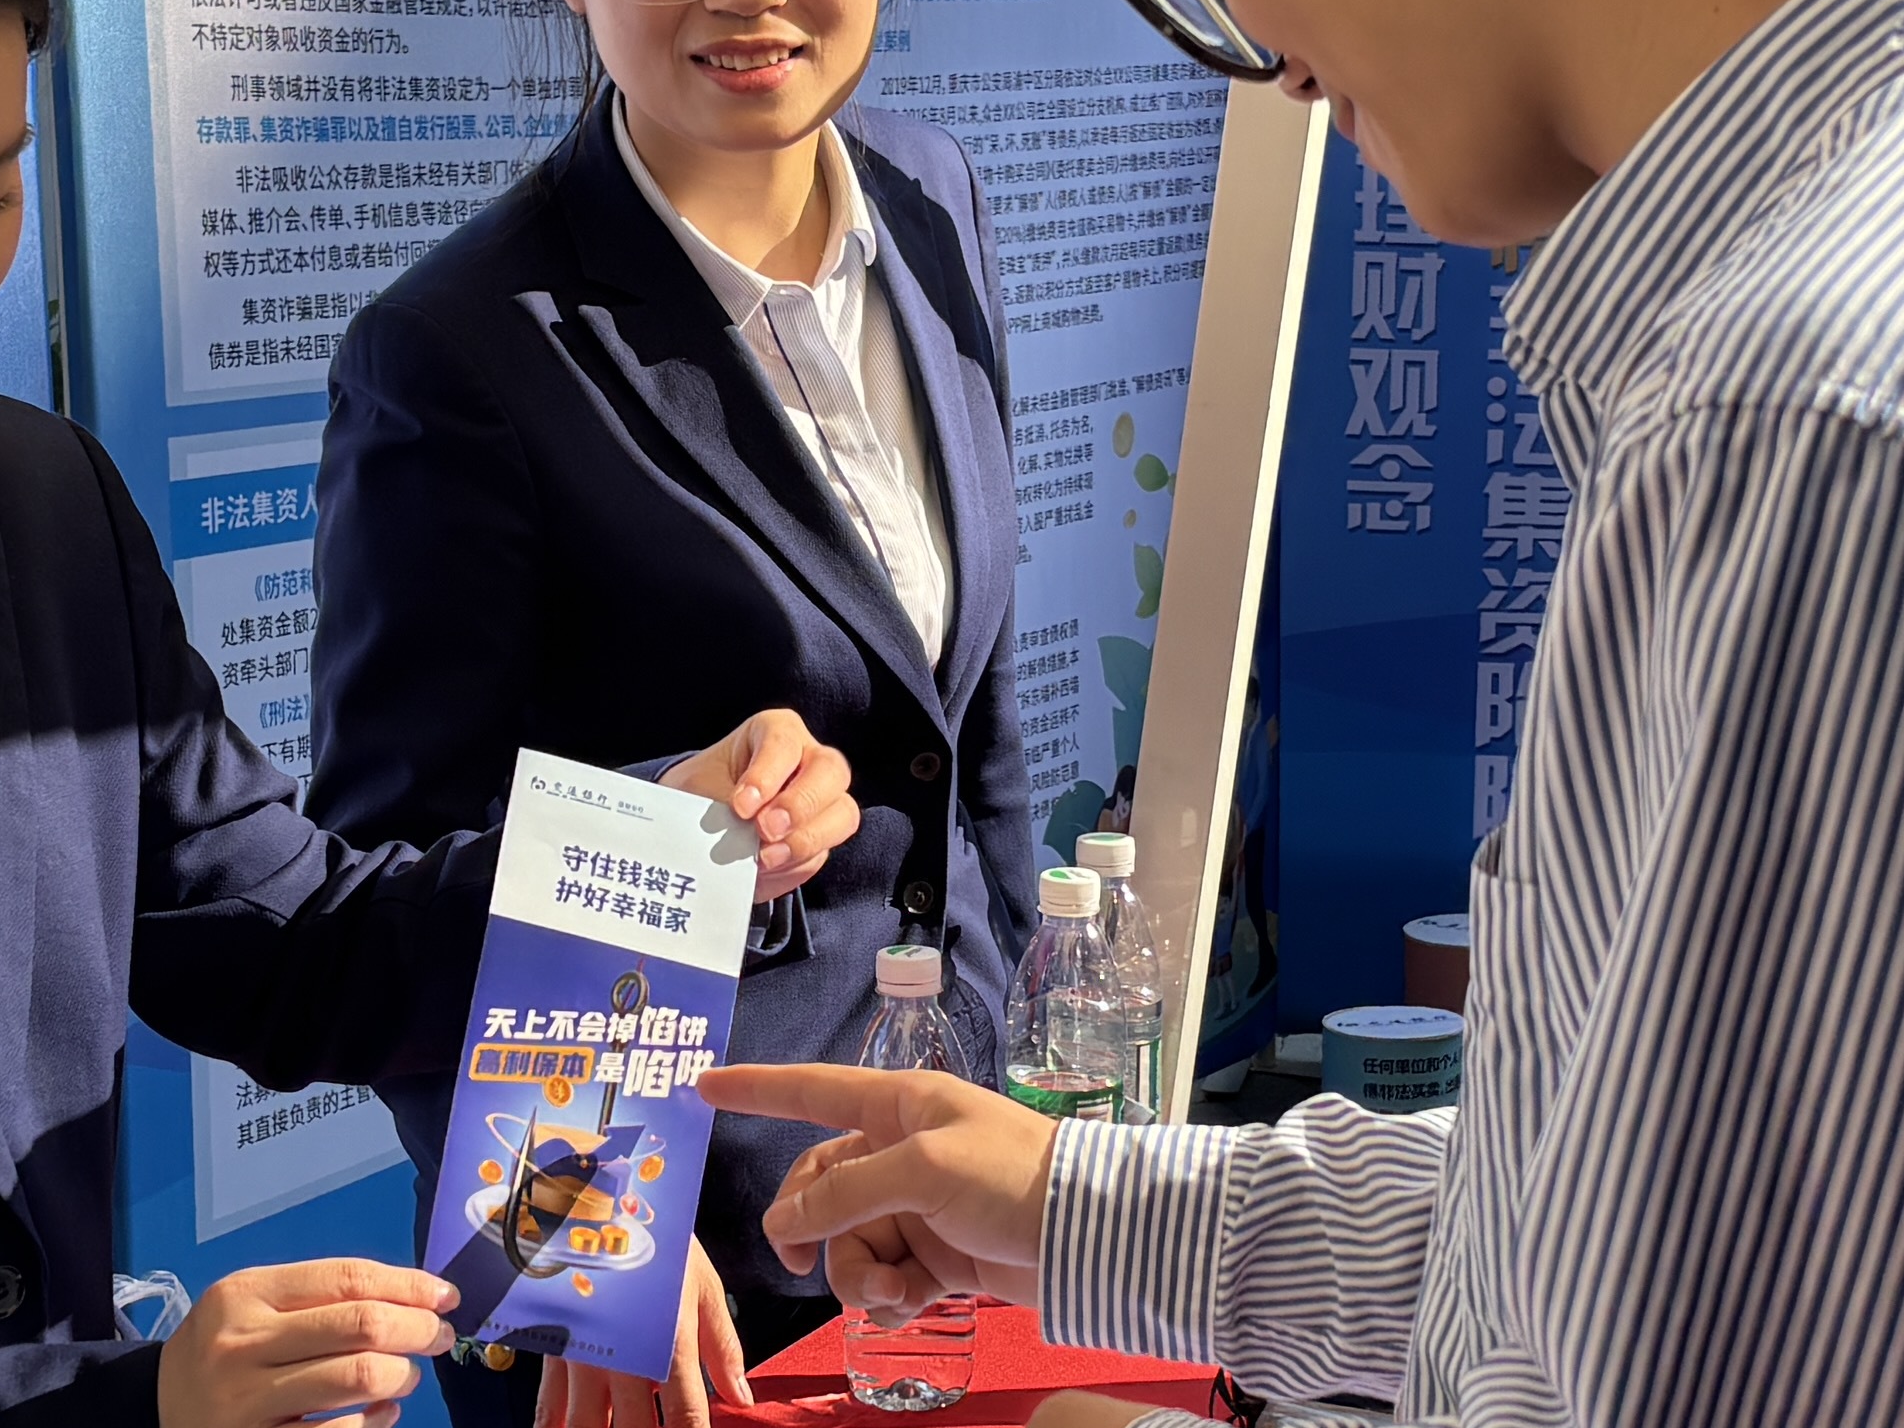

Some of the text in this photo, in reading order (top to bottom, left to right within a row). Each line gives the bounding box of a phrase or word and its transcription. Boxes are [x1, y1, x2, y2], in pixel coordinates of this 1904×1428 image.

[561, 843, 697, 901] 守住钱袋子
[554, 875, 692, 935] 护好幸福家
[483, 1005, 709, 1047] 天上不会掉馅饼
[593, 1048, 716, 1099] 是陷阱
